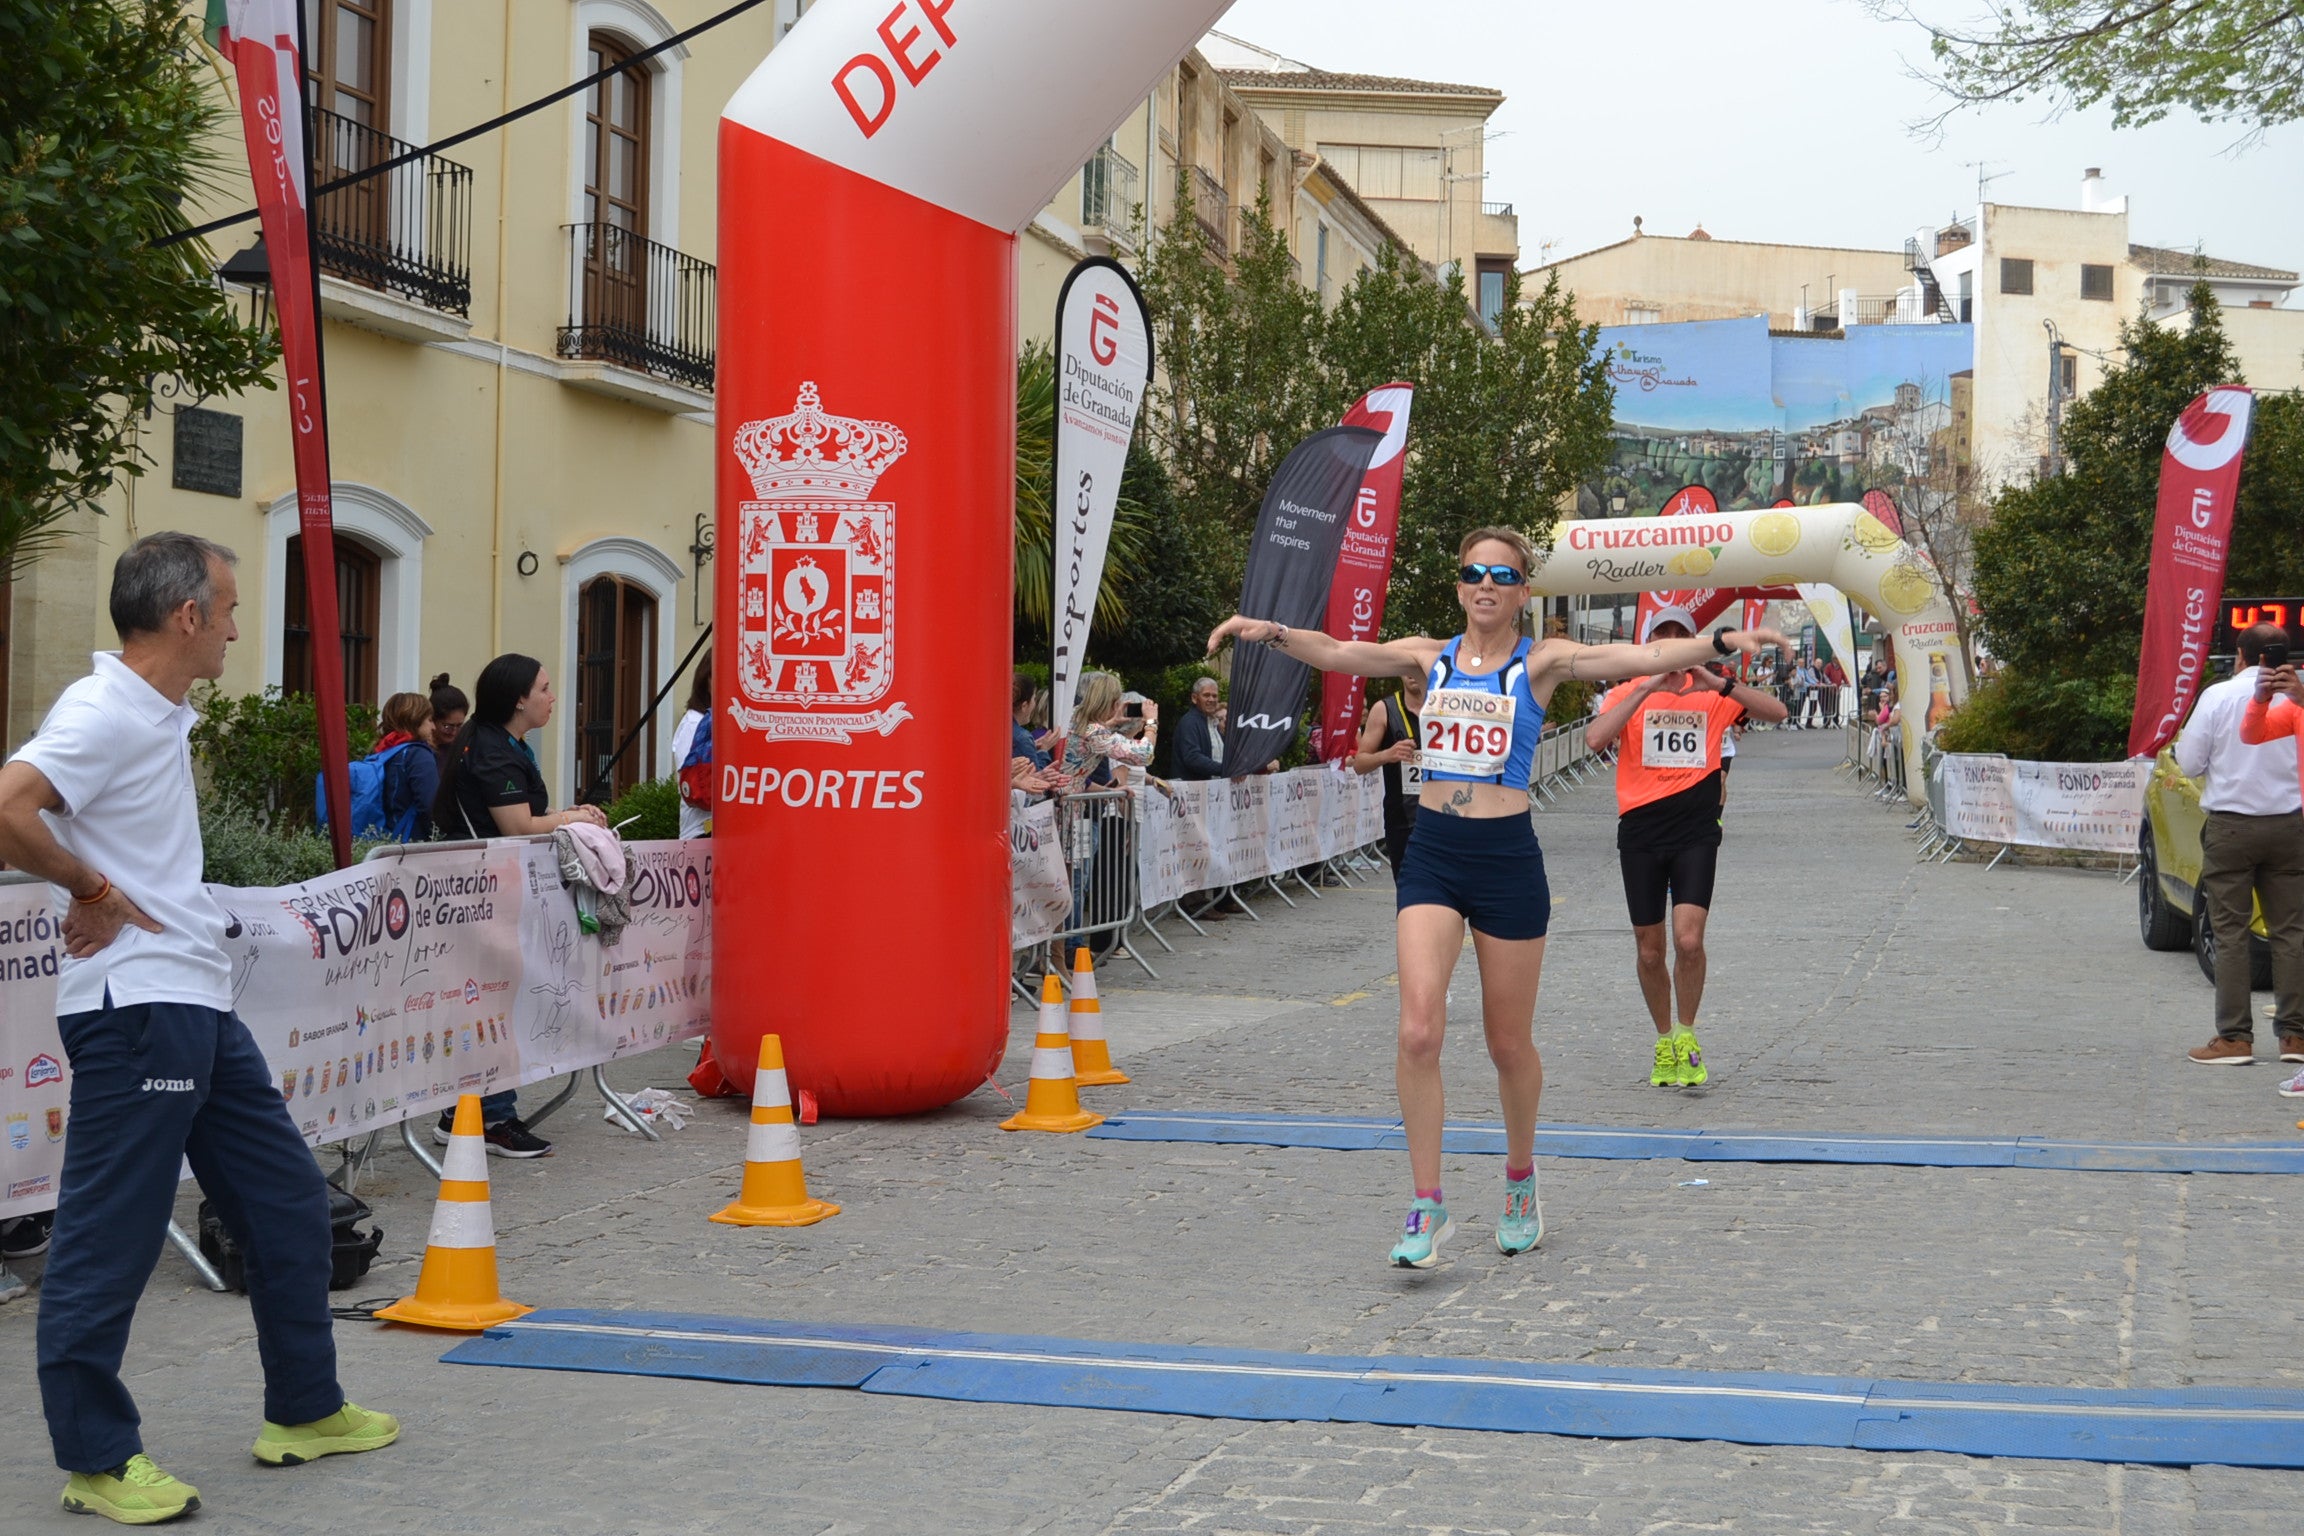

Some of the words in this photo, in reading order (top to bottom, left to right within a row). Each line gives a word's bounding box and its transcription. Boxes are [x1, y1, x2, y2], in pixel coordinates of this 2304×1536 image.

[1631, 351, 1662, 363] Turismo
[1065, 353, 1133, 404] Diputación
[1063, 381, 1079, 405] de
[1081, 389, 1132, 428] Granada
[1279, 499, 1336, 523] Movement
[1275, 516, 1297, 530] that
[1270, 531, 1310, 550] inspires
[1569, 523, 1733, 550] Cruzcampo
[2175, 525, 2221, 547] Diputación
[2185, 542, 2220, 560] Granada
[1587, 557, 1667, 582] Radler
[1908, 637, 1943, 650] Radler
[1440, 697, 1497, 713] FONDO
[774, 723, 838, 736] GRANADA
[816, 716, 862, 726] PROVINCIAL
[1426, 720, 1508, 756] 2169
[1653, 730, 1697, 753] 166
[722, 764, 925, 809] DEPORTES
[2058, 773, 2101, 790] FONDO
[290, 888, 346, 914] GRAN
[344, 872, 392, 903] PREMIO
[415, 868, 498, 905] Diputación
[303, 888, 409, 958] FONDO
[389, 903, 405, 924] 24
[415, 903, 431, 928] de
[435, 897, 493, 925] Granada
[303, 1028, 325, 1041] SABOR
[326, 1021, 348, 1036] GRANADA
